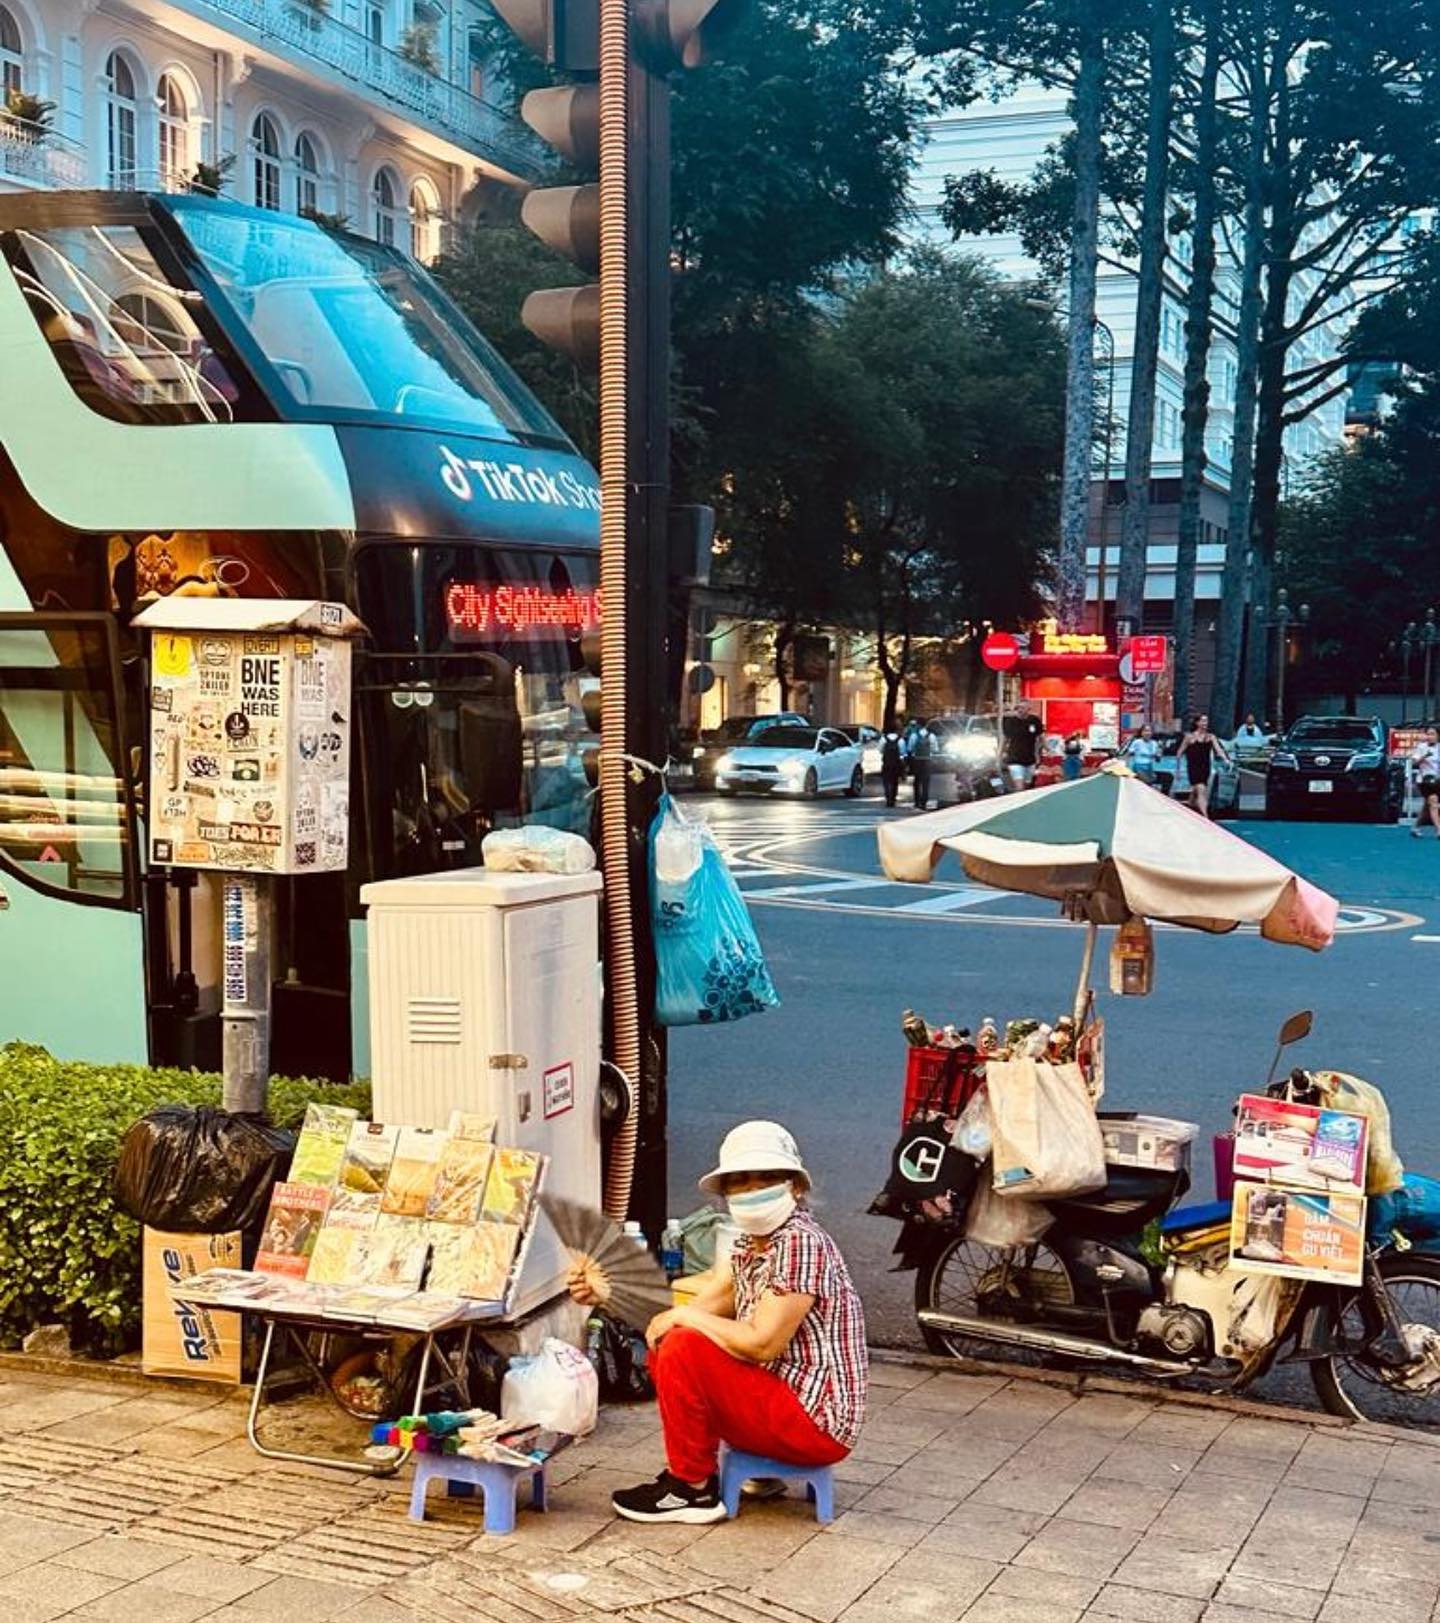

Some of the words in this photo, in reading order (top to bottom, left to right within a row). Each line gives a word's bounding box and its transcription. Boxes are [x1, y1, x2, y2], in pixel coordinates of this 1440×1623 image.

[468, 460, 568, 506] TikTok
[447, 584, 490, 632] City
[495, 586, 591, 632] Sightseeing
[241, 658, 280, 686] BNE
[241, 686, 280, 701] WAS
[241, 702, 280, 718] HERE
